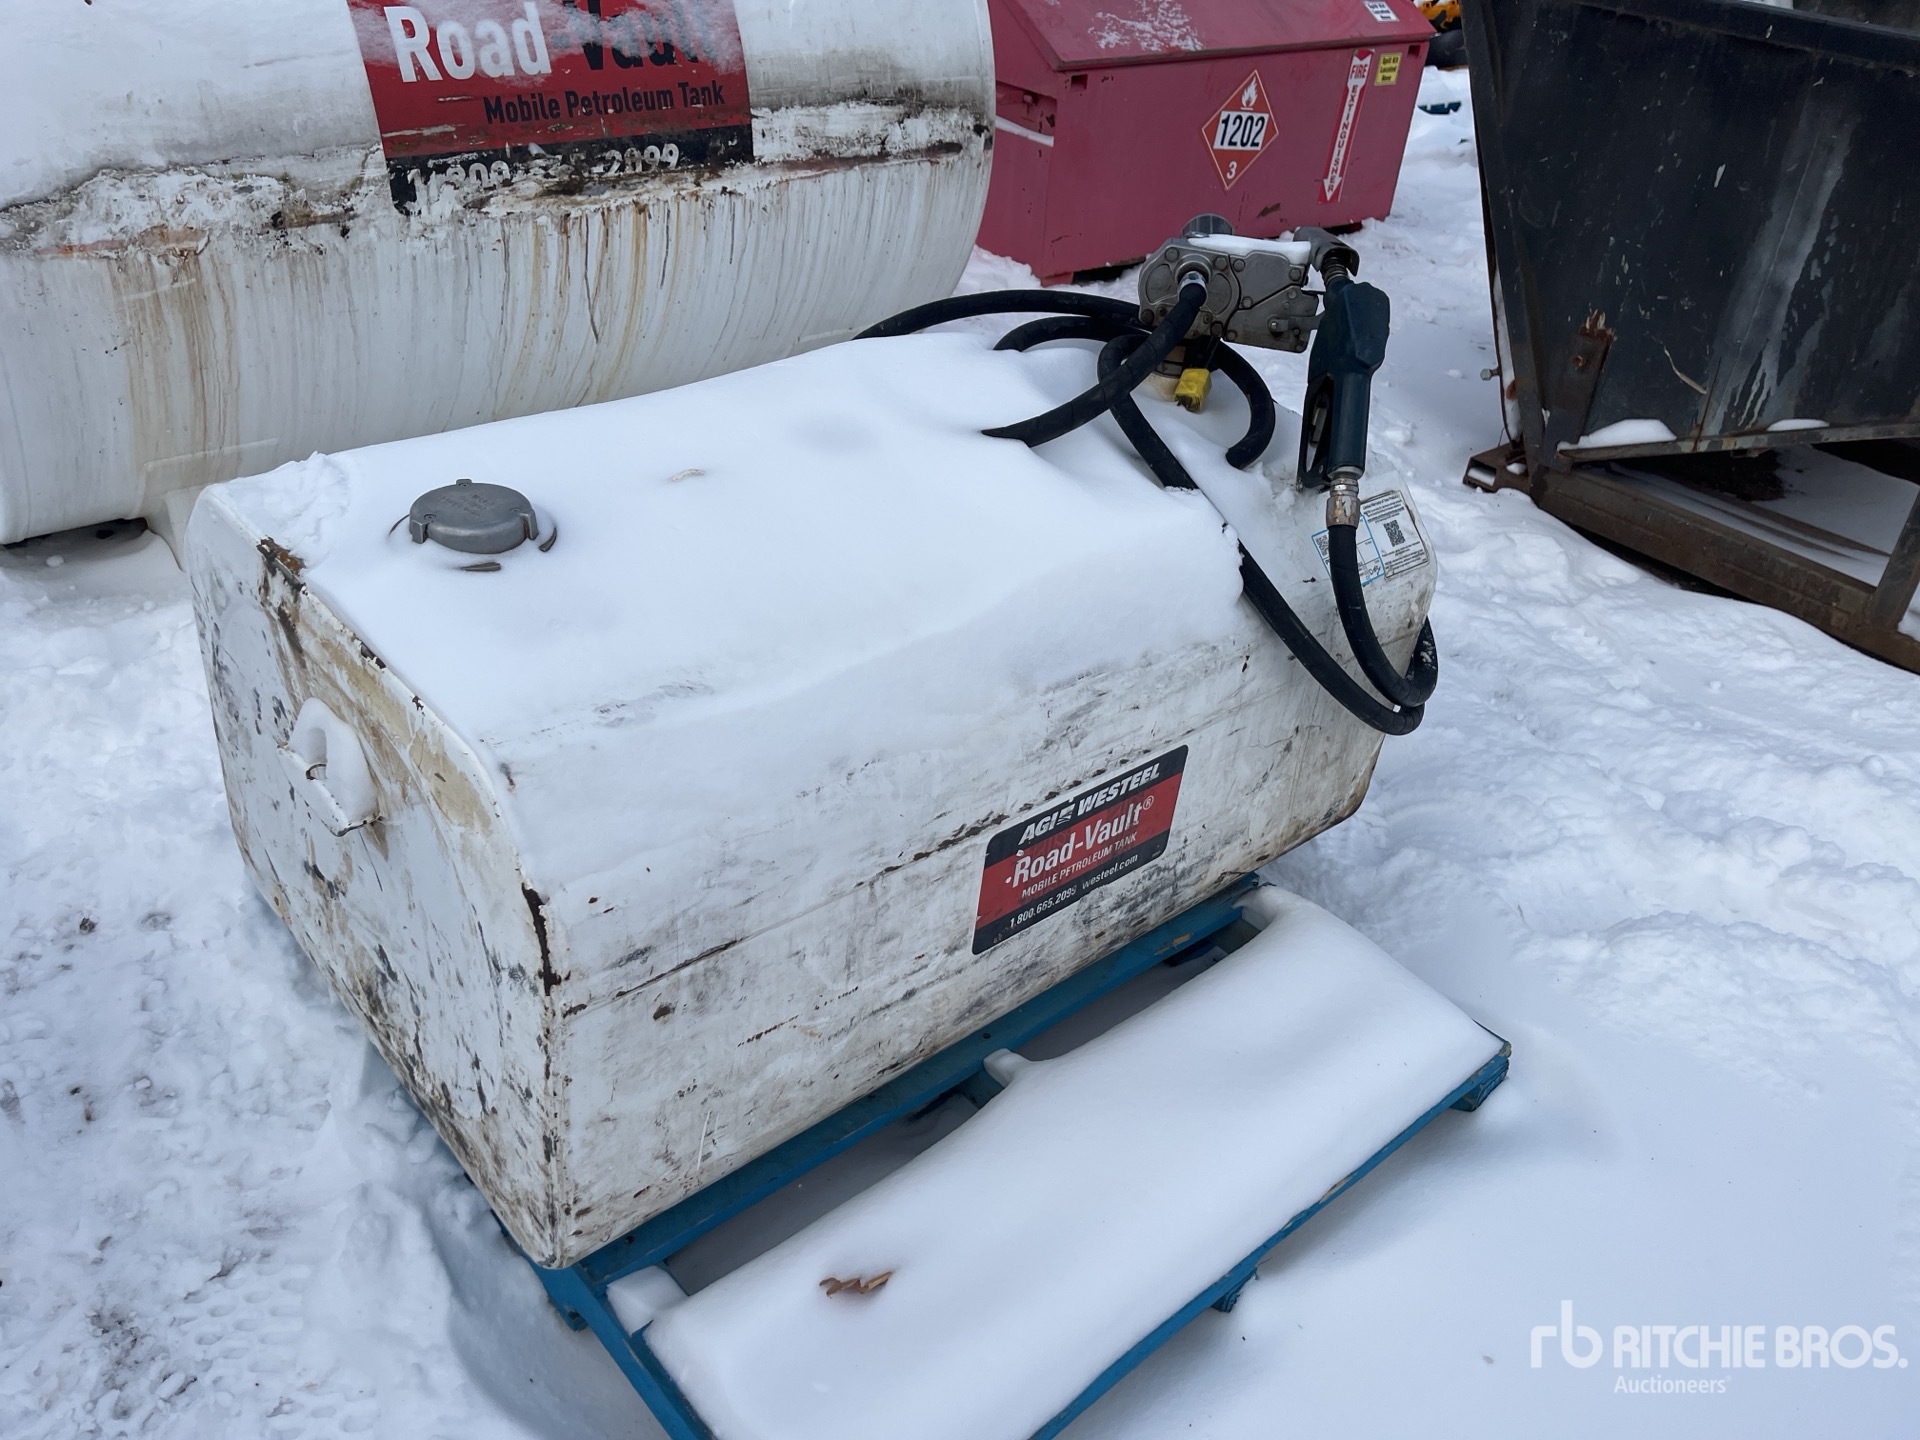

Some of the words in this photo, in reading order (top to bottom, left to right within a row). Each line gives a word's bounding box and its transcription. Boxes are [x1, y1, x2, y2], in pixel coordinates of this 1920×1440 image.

[1350, 64, 1368, 79] FIRE
[483, 92, 561, 125] Mobile
[565, 86, 675, 119] Petroleum
[677, 80, 726, 107] Tank
[1220, 113, 1265, 148] 1202
[1327, 85, 1359, 192] EXTINGUISHER
[1226, 161, 1238, 179] 3
[1018, 810, 1059, 845] AGI
[1077, 763, 1160, 816] WESTEEL
[1021, 872, 1059, 899] MOBILE
[1060, 844, 1112, 880] PETROLEUM
[1114, 832, 1138, 851] TANK
[1082, 854, 1139, 890] westeel.com
